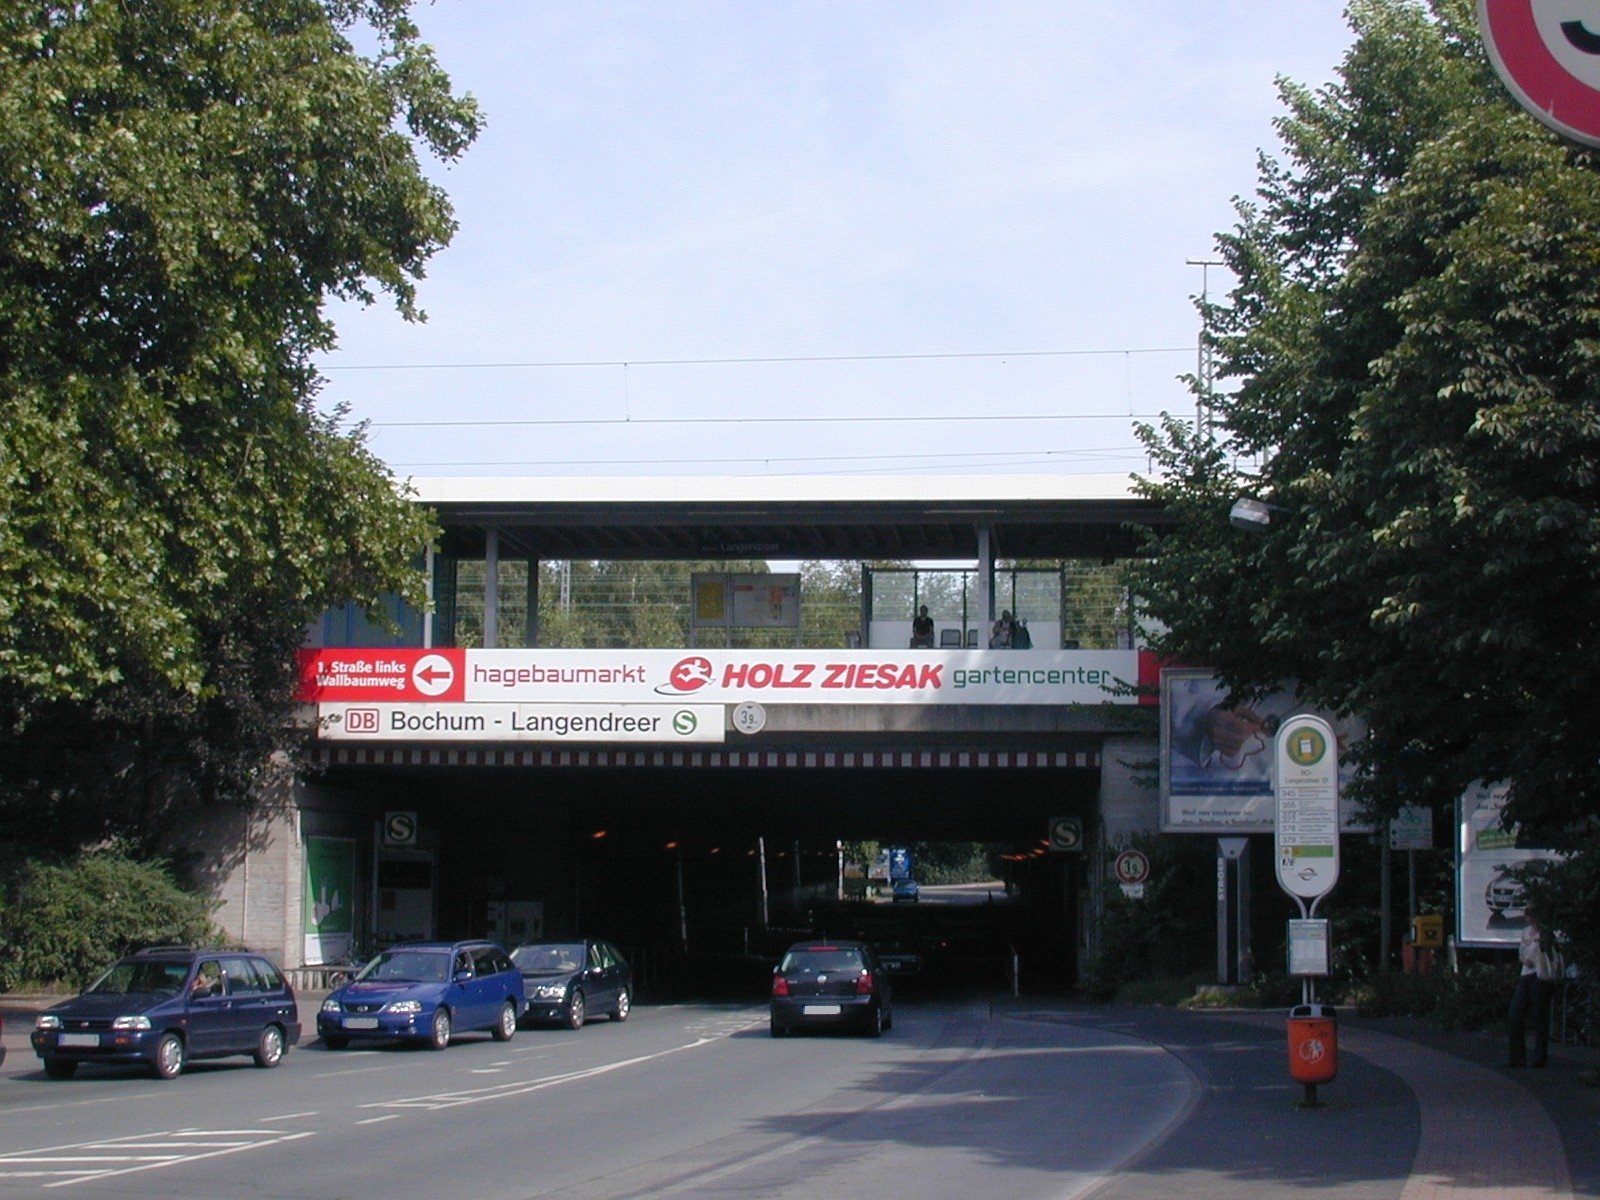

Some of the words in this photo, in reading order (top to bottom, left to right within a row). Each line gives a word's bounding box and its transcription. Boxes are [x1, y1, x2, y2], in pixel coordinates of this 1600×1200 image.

[331, 660, 373, 674] Straße
[375, 660, 406, 674] links
[473, 663, 646, 688] hagebaumarkt
[721, 663, 816, 689] HOLZ
[820, 662, 944, 689] ZIESAK
[953, 666, 1110, 689] gartencenter
[315, 673, 406, 691] Wallbaumweg
[349, 712, 376, 730] DB
[390, 710, 485, 731] Bochum
[511, 710, 661, 735] Langendreer
[391, 816, 409, 840] S
[1056, 822, 1076, 847] S
